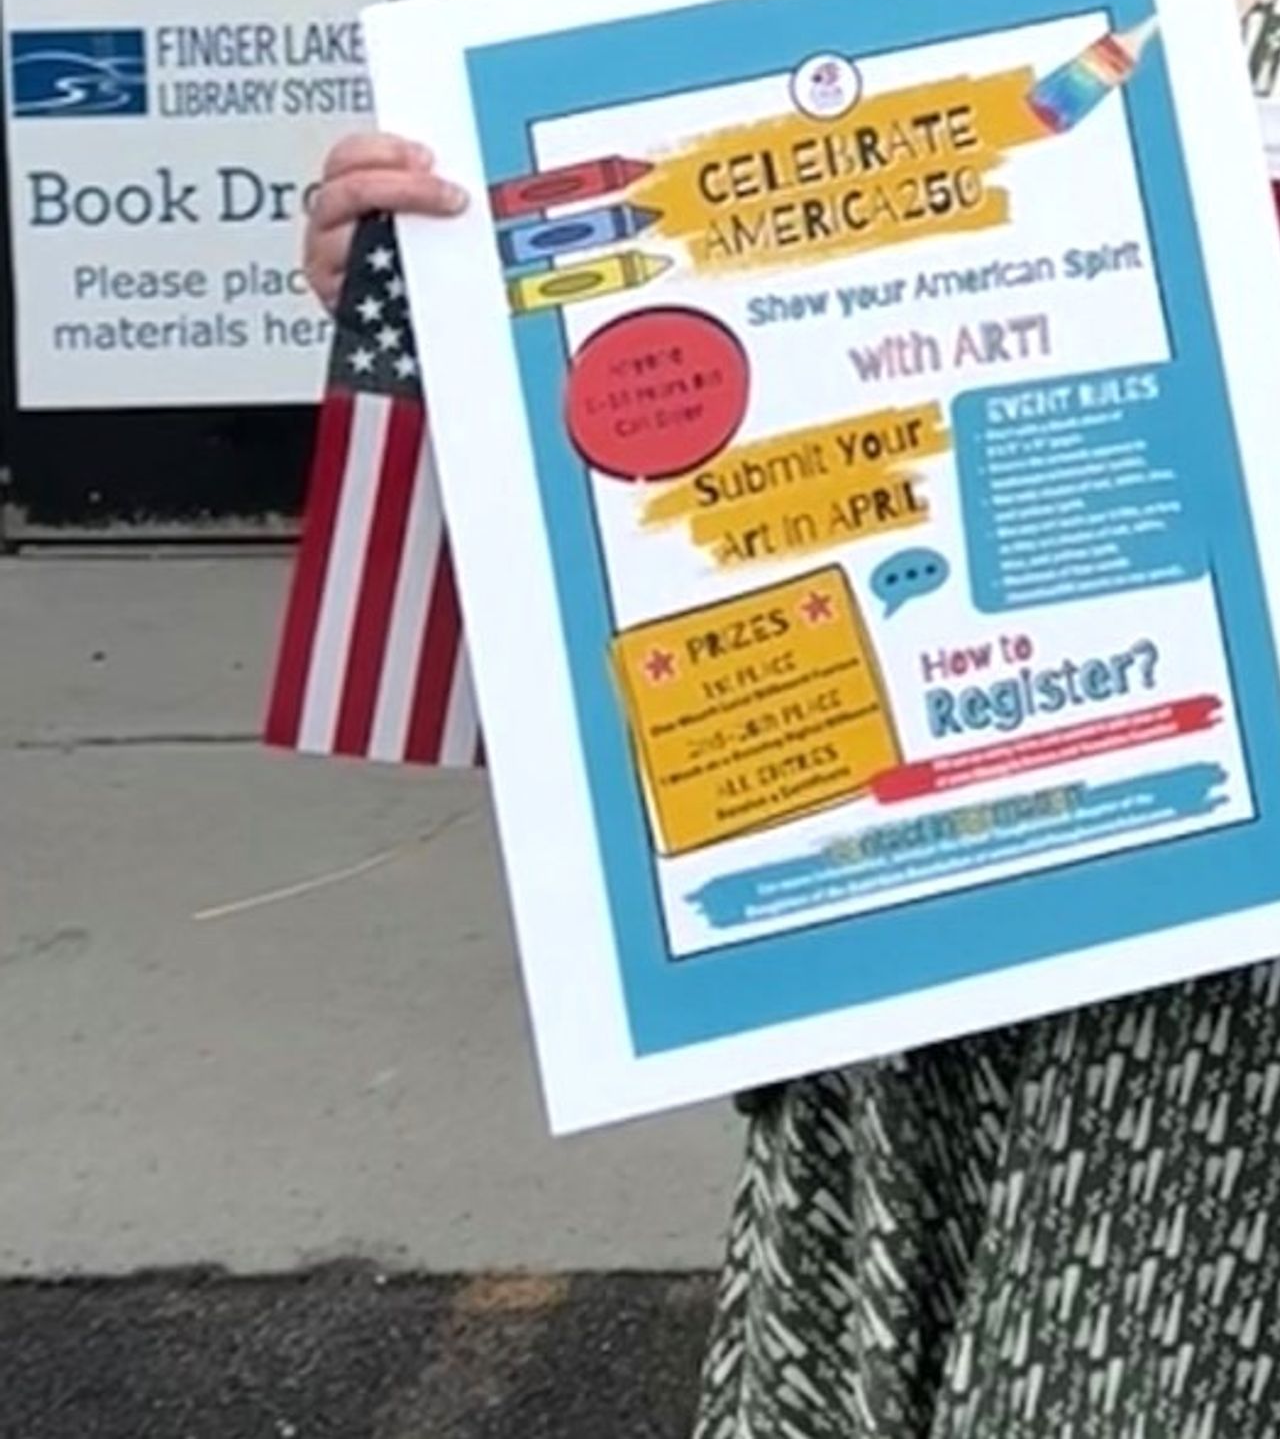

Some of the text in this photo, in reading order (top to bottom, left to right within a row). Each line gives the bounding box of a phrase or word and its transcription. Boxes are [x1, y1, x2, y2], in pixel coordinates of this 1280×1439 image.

[156, 22, 366, 68] FINGER LAKE
[158, 80, 277, 117] LIBRARY
[699, 105, 978, 205] CELEBRATE
[27, 166, 321, 226] Book Dr
[703, 164, 984, 260] AMERICA250
[73, 262, 308, 303] Please plac
[747, 241, 1144, 327] Show your American Spirit
[53, 312, 334, 351] materials her
[848, 333, 940, 384] with
[986, 373, 1158, 423] EVENT RULES
[695, 417, 924, 508] Submit Your
[718, 479, 928, 567] Art in APRIL
[686, 609, 789, 663] PRIZES
[920, 634, 1034, 682] How to
[925, 639, 1161, 740] Register?
